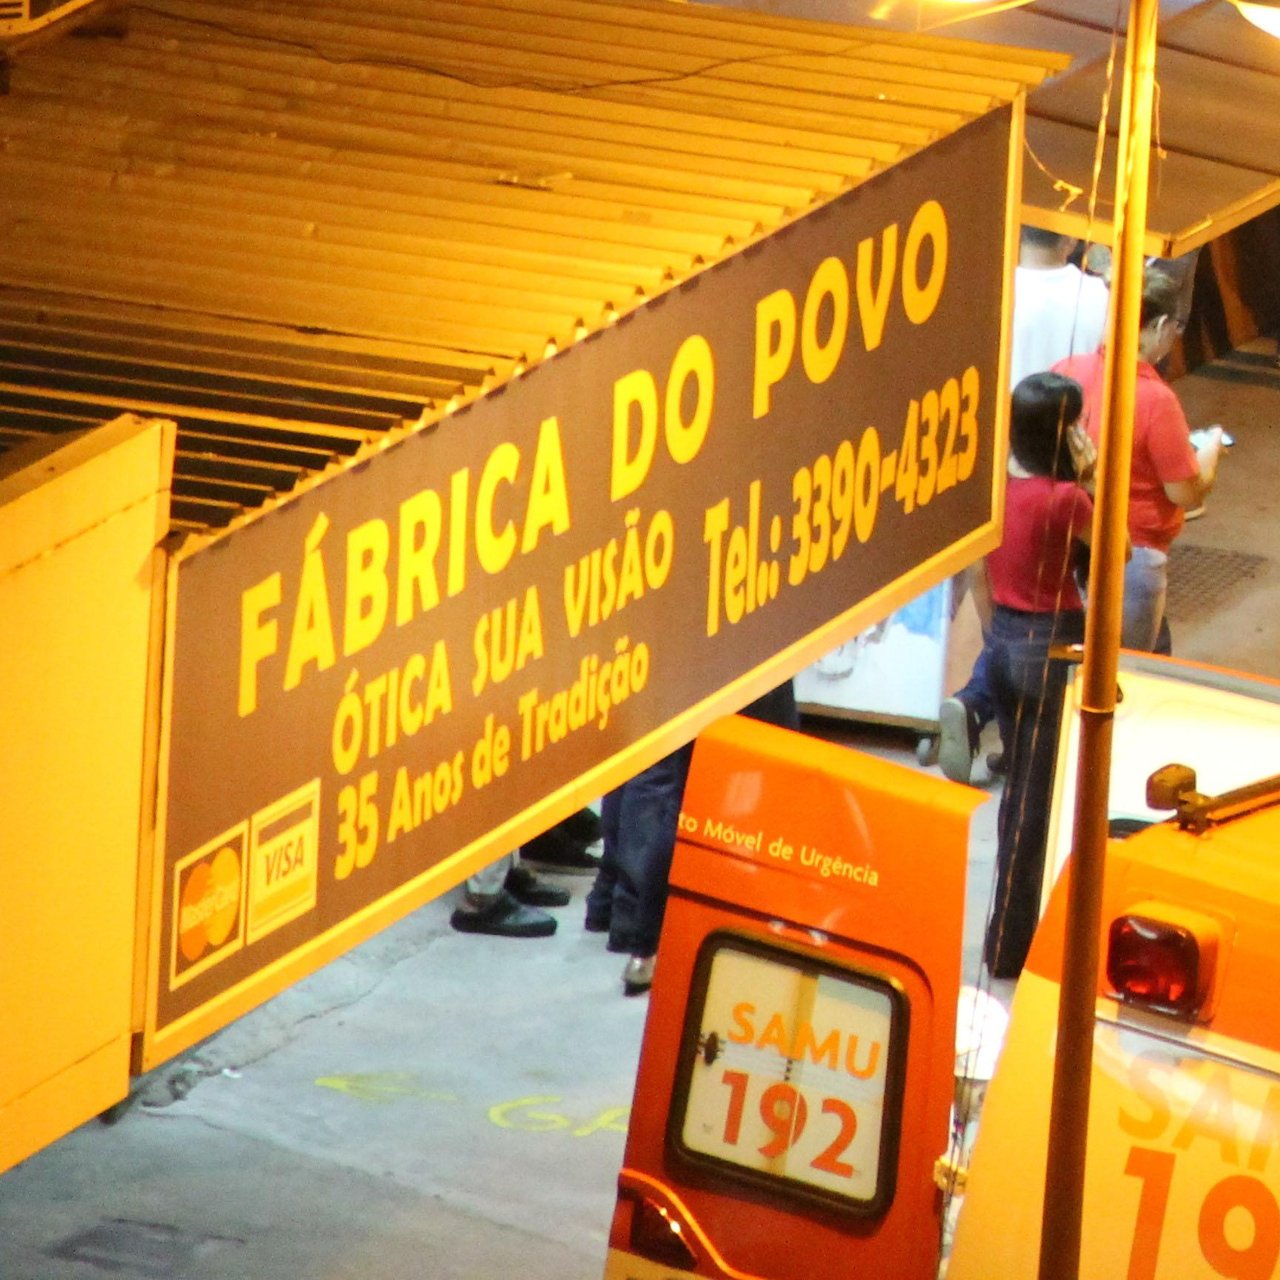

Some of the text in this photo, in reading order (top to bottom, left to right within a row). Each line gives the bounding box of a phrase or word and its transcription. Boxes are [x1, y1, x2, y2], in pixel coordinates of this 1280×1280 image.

[237, 199, 949, 717] FÁBRICA DO POVO
[703, 366, 982, 638] Tel.: 3390-4323
[332, 507, 673, 776] ÓTICA SUA VISÃO
[334, 634, 650, 882] 35 Anos de Tradição
[264, 834, 306, 888] VISA
[703, 818, 764, 852] Móvel
[767, 837, 795, 861] de
[799, 846, 880, 887] Urgência
[722, 1070, 858, 1180] 192
[727, 1002, 882, 1081] SAMU
